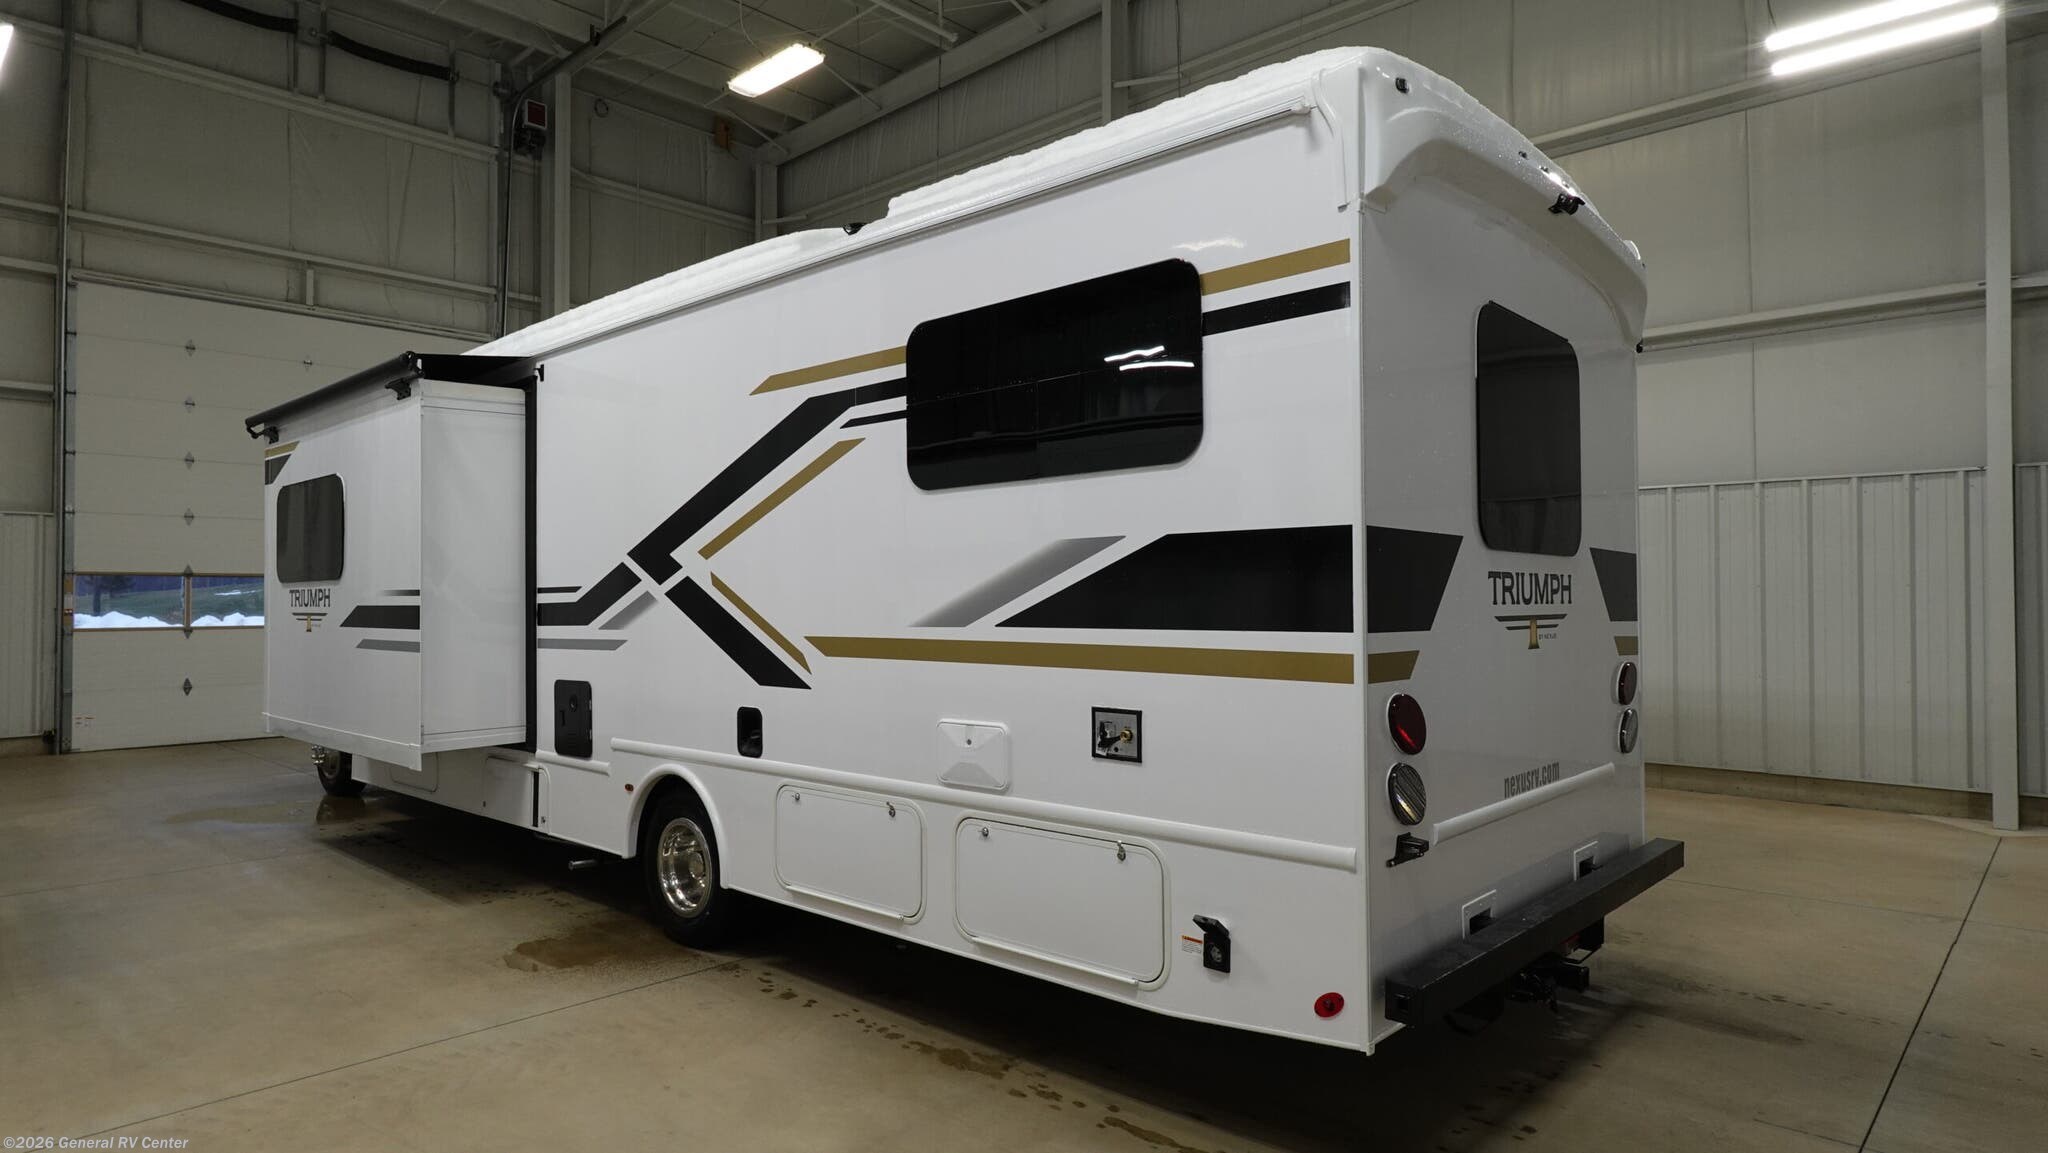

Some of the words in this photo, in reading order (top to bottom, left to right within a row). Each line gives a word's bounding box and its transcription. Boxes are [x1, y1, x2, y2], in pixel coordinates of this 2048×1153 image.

[289, 588, 331, 607] TRIUMPH
[1487, 571, 1572, 605] TRIUMPH
[1504, 762, 1560, 799] nexusrv.com
